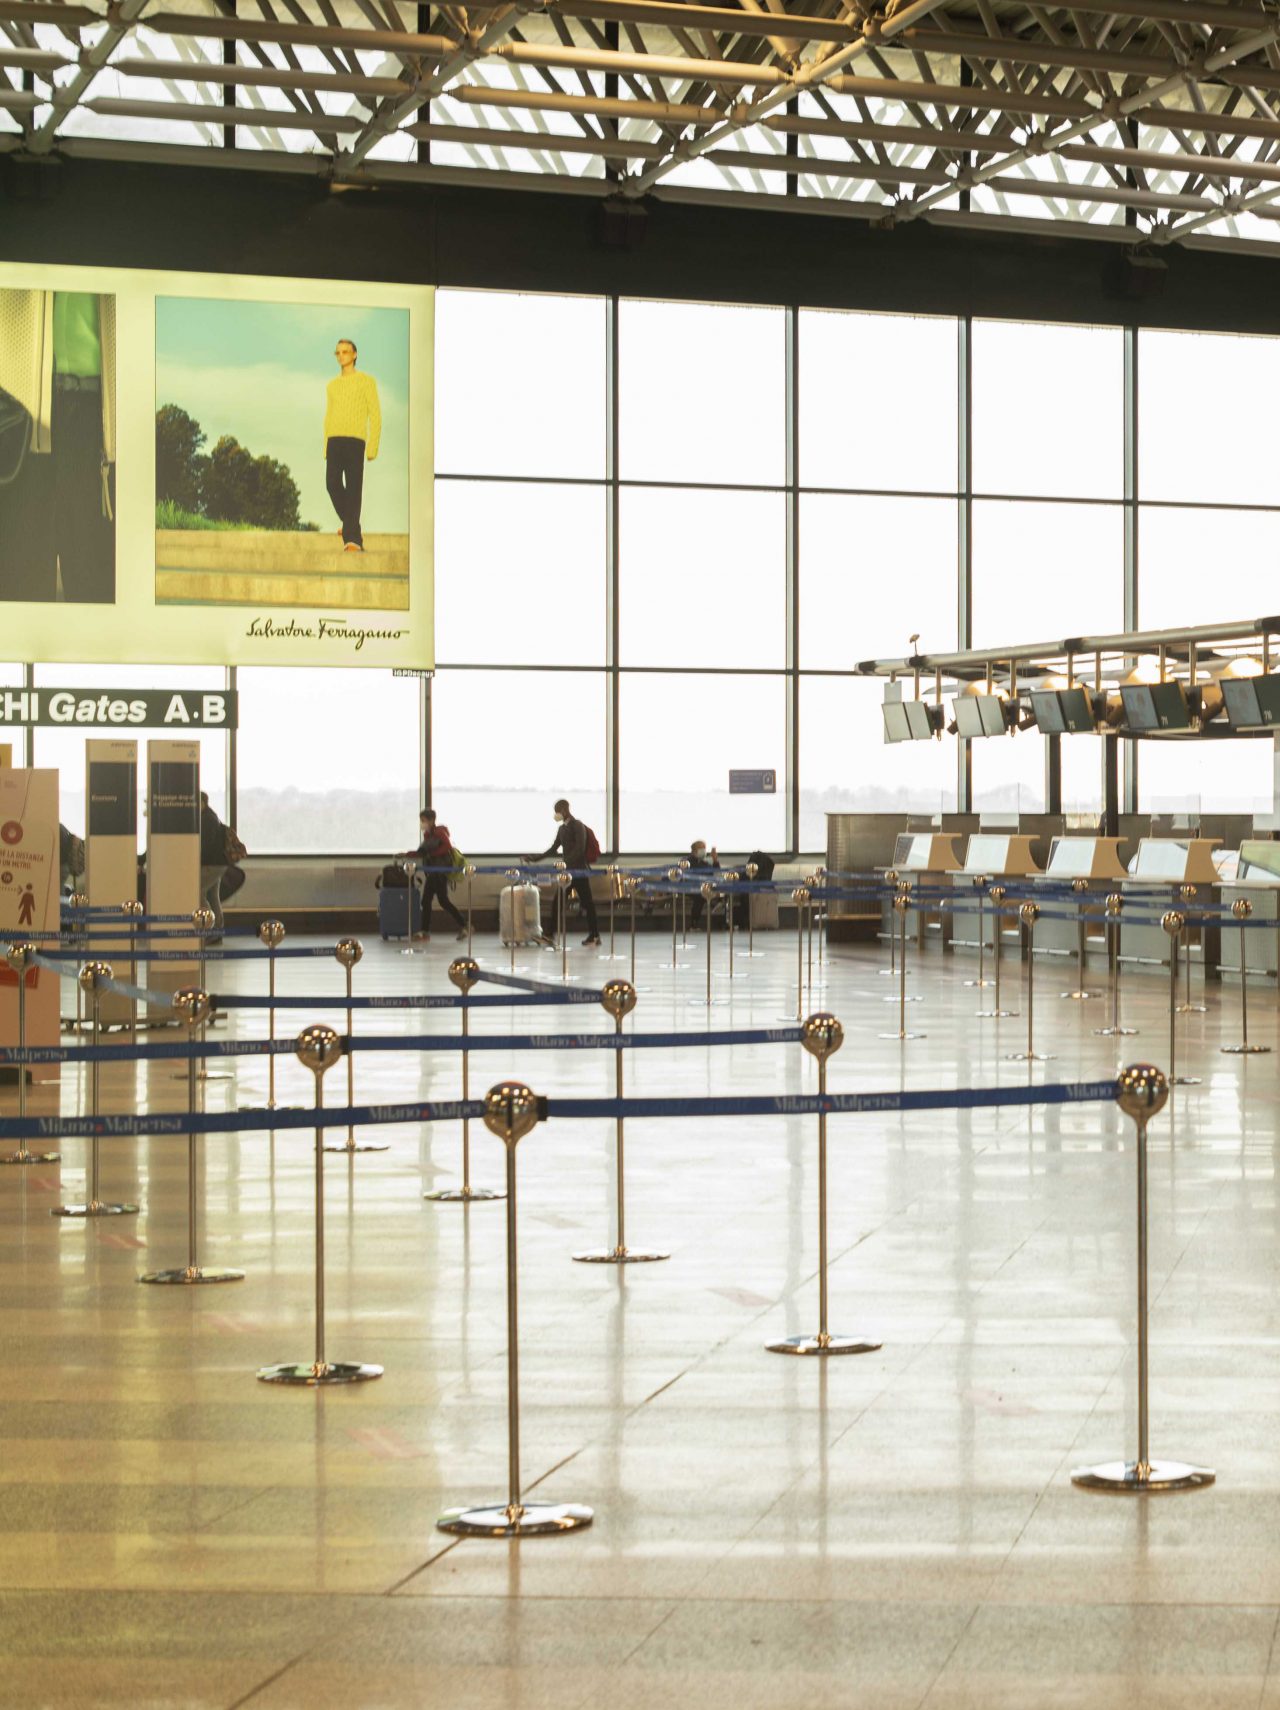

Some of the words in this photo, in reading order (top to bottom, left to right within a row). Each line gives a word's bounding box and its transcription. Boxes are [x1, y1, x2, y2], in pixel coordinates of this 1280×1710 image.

[246, 617, 313, 639] Salvatore
[318, 618, 410, 651] Ferragamo
[0, 692, 39, 722] HI
[48, 692, 147, 723] Gates
[369, 996, 402, 1007] Milano
[408, 995, 455, 1008] Malpensa
[568, 993, 600, 1002] Milano
[220, 1041, 261, 1054] Milano
[529, 1035, 569, 1047] Milano
[576, 1034, 632, 1048] Malpensa
[6, 1047, 67, 1064] Malpensa
[1065, 1083, 1113, 1099] Milano
[774, 1095, 823, 1111] Milano
[831, 1094, 900, 1111] Malpensa
[368, 1105, 420, 1121] Milano
[38, 1117, 94, 1134] Milano
[104, 1115, 182, 1135] Malpensa
